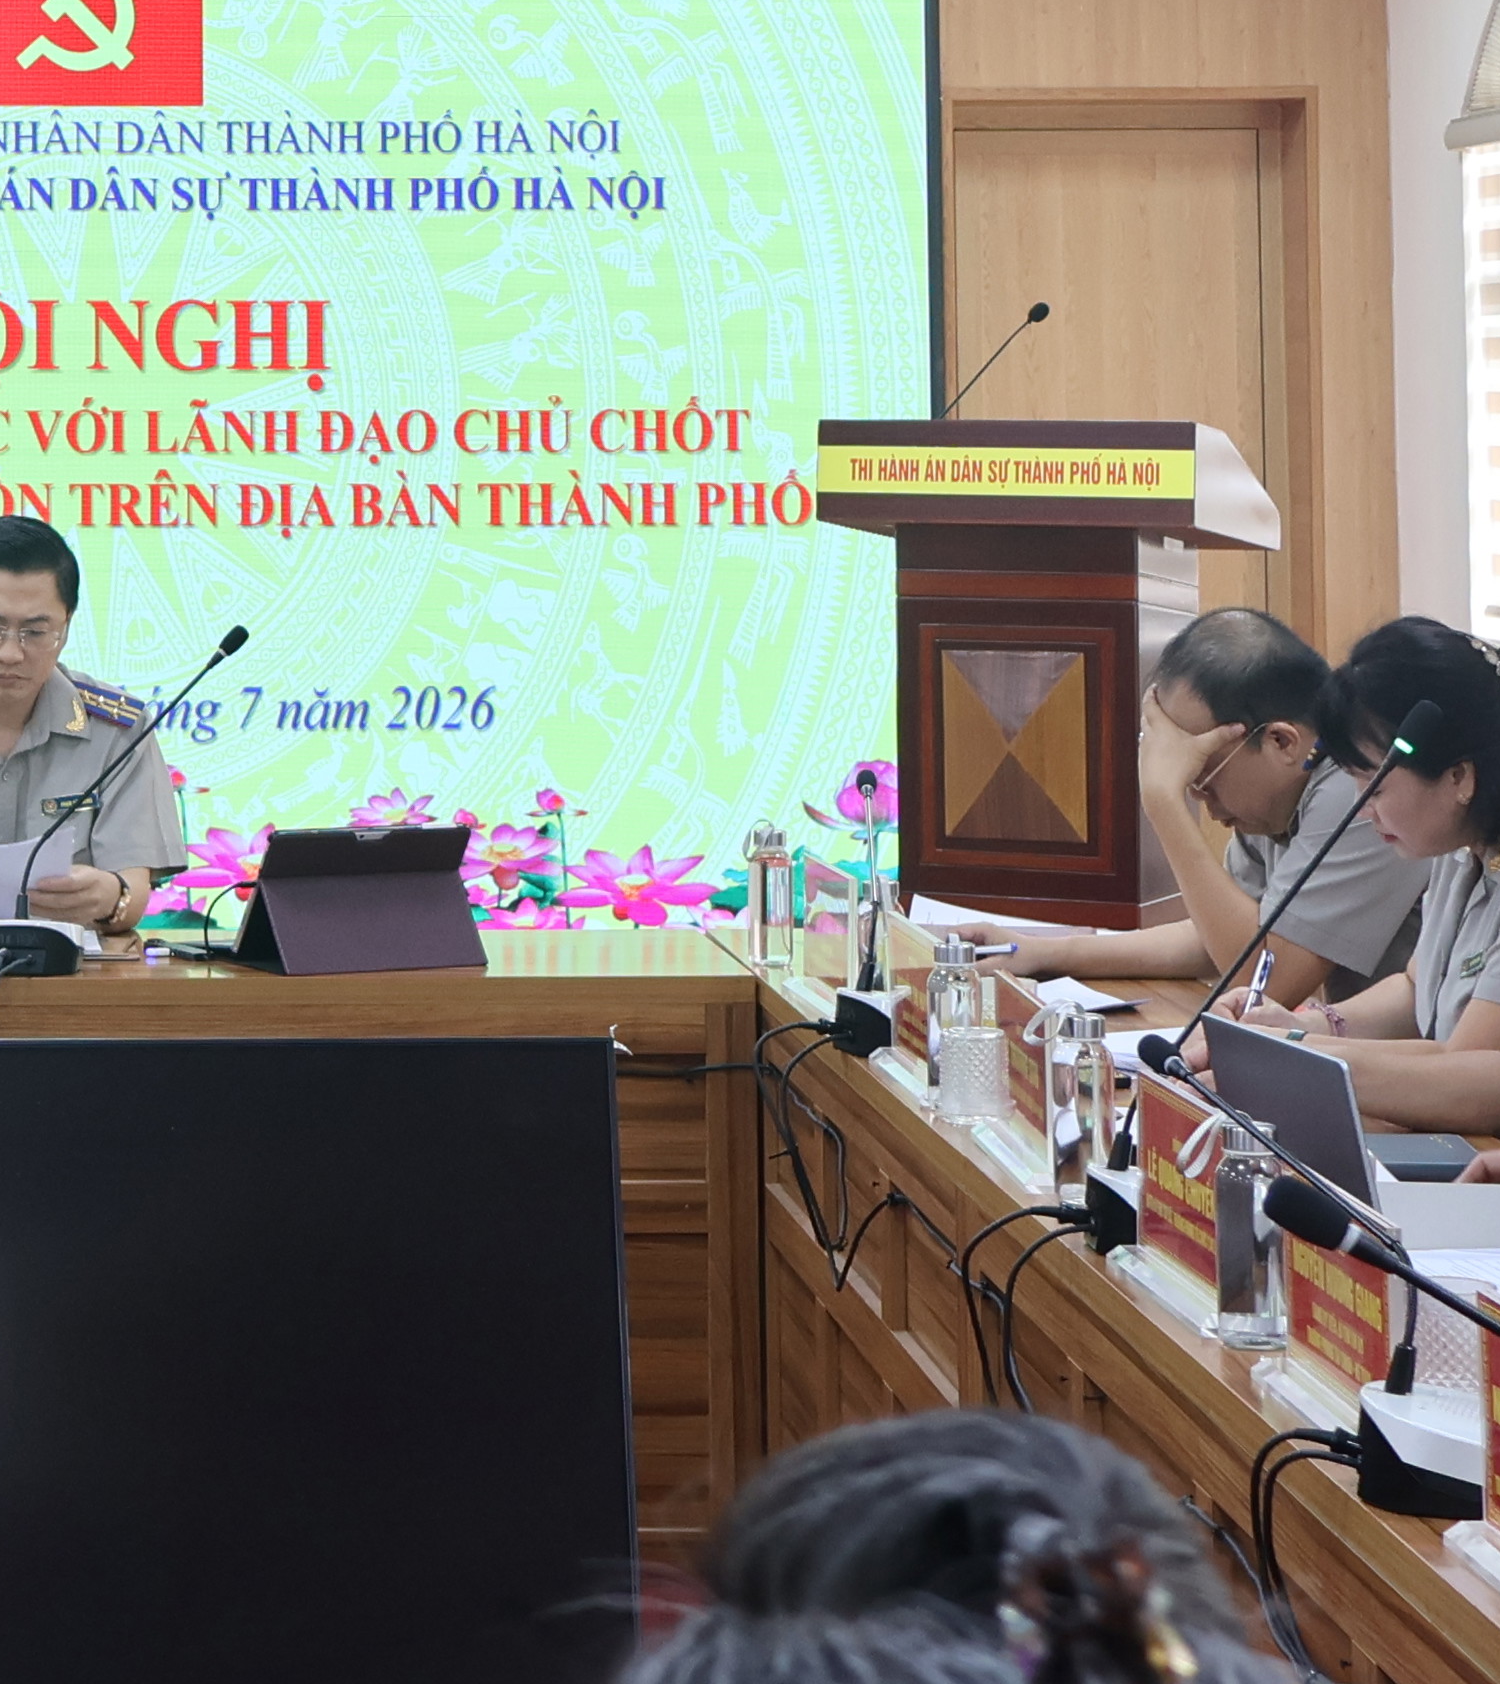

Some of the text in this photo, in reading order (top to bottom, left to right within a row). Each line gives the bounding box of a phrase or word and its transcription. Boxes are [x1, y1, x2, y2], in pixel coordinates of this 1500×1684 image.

[116, 110, 204, 155] DÂN
[217, 109, 365, 155] THÀNH
[379, 109, 462, 154] PHỐ
[474, 109, 534, 154] HÀ
[546, 108, 620, 160] NỘI
[69, 166, 158, 212] DÂN
[172, 171, 231, 218] SỰ
[239, 167, 394, 212] THÀNH
[410, 166, 499, 212] PHỐ
[513, 166, 575, 210] HÀ
[588, 170, 666, 218] NỘI
[87, 299, 330, 393] NGHỊ
[26, 397, 125, 454] VỚI
[146, 399, 299, 454] LÃNH
[316, 409, 438, 465] ĐẠO
[453, 396, 570, 454] CHỦ
[590, 396, 750, 454] CHỐT
[850, 453, 1160, 491] THI HÀNH ÁN DÂN SỰ THÀNH PHỐ HÀ NỘI
[68, 469, 218, 527] TRÊN
[238, 484, 335, 539] ĐỊA
[351, 470, 461, 528] BÀN
[477, 470, 678, 527] THÀNH
[697, 469, 813, 526] PHỐ
[240, 687, 263, 729] 7
[276, 688, 369, 731] năm
[386, 685, 495, 730] 2026
